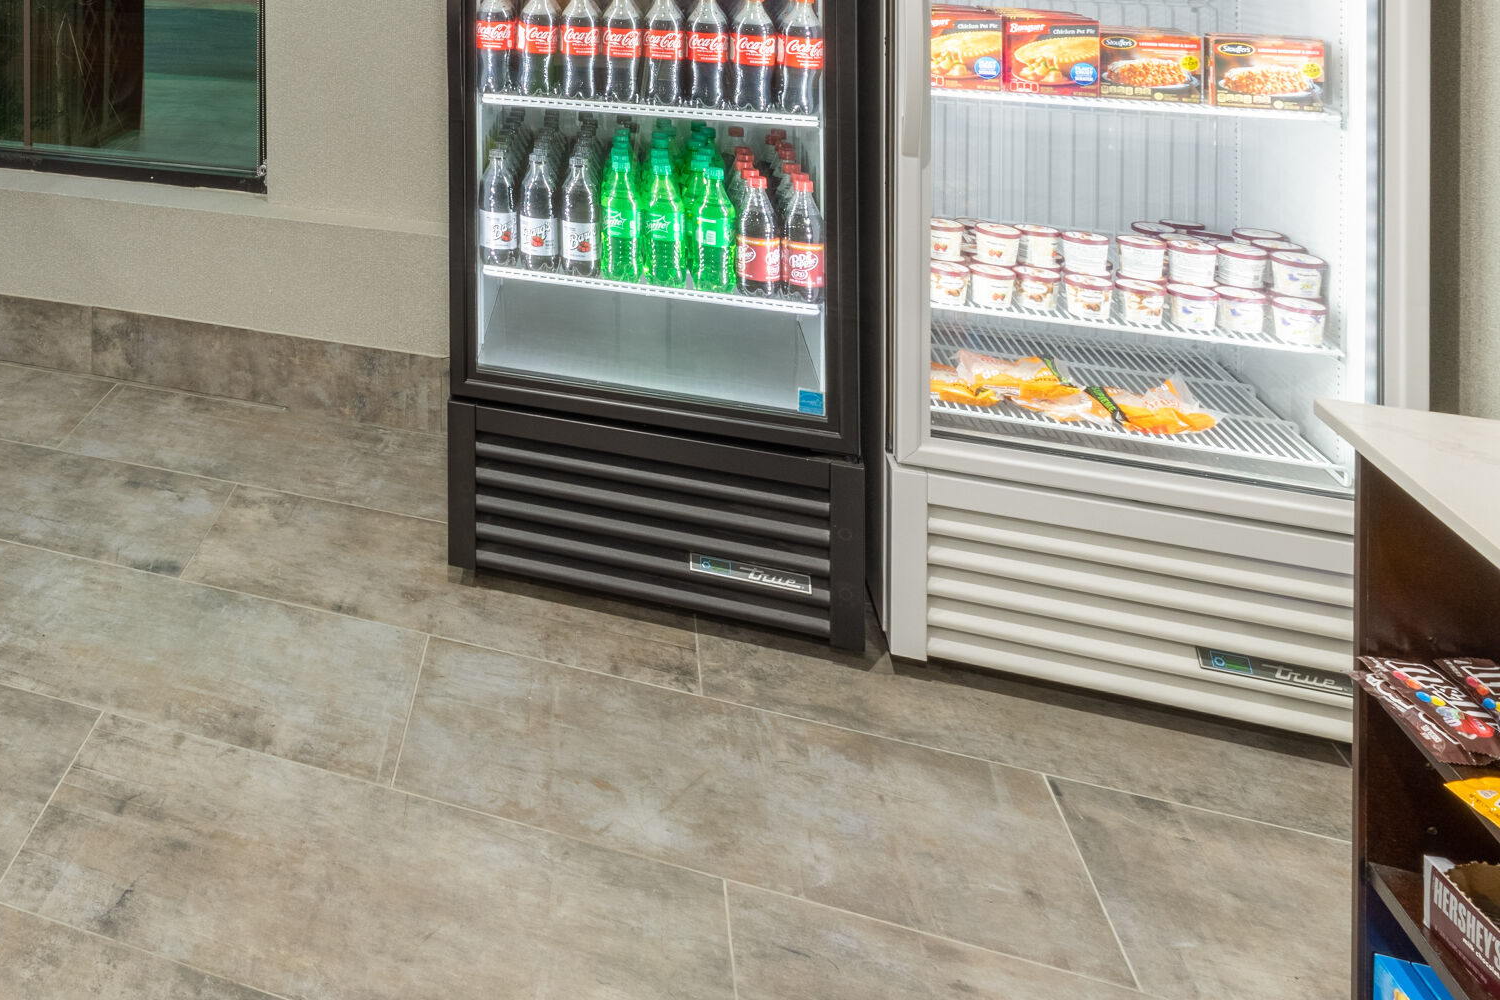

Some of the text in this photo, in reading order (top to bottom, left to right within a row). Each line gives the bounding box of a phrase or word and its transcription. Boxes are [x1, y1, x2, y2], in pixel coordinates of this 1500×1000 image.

[1010, 22, 1046, 33] Banquet
[740, 566, 802, 590] true
[1261, 662, 1343, 691] true
